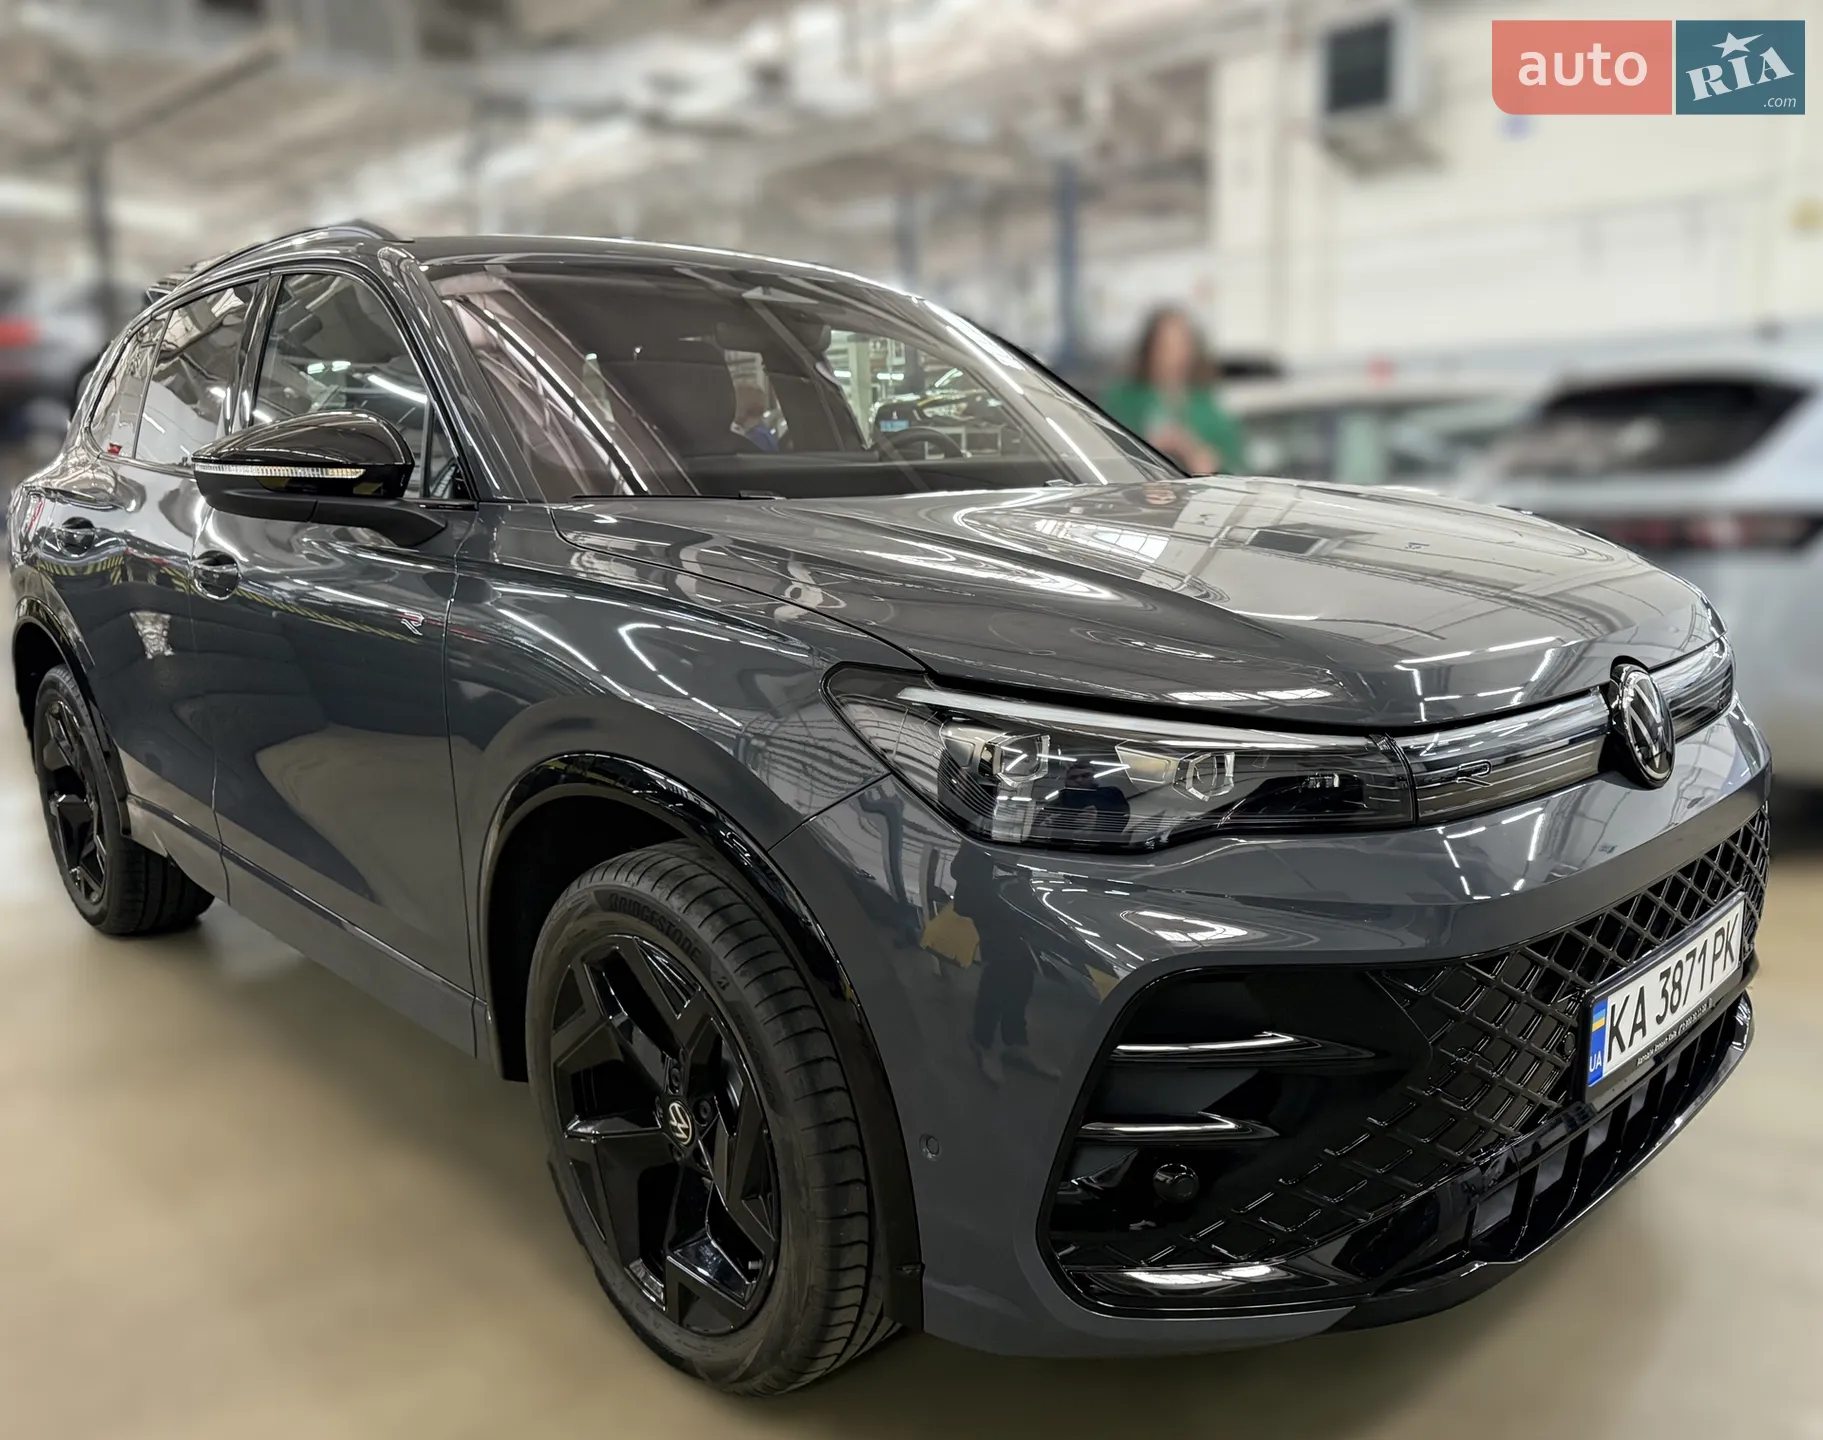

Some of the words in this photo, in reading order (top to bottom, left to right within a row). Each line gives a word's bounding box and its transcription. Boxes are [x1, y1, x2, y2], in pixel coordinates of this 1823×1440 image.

[1606, 985, 1648, 1063] KA
[1655, 937, 1708, 1026] 3871
[1709, 912, 1739, 984] PK
[1588, 1049, 1603, 1073] UA
